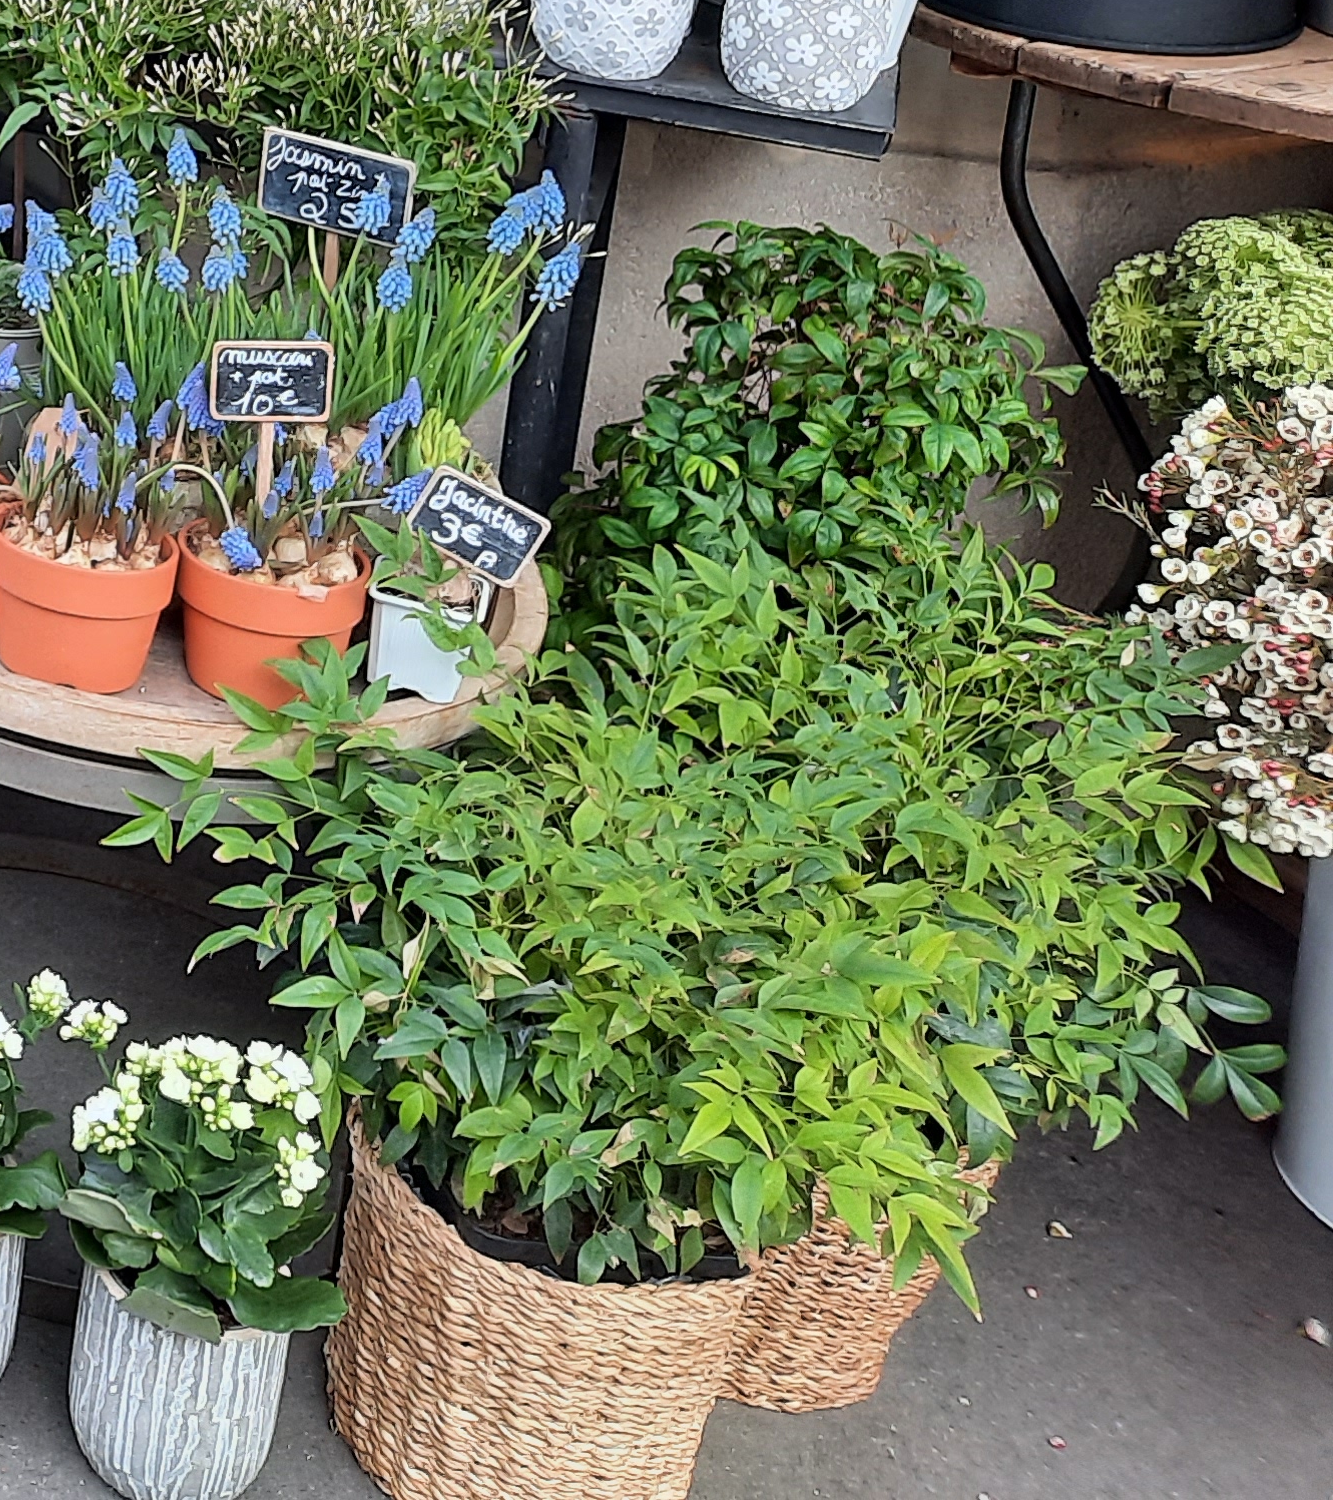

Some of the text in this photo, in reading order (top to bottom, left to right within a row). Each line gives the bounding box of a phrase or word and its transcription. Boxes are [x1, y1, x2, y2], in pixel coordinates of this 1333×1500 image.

[230, 389, 299, 416] 10€
[428, 477, 529, 546] Jacinthe
[431, 512, 483, 547] 3€
